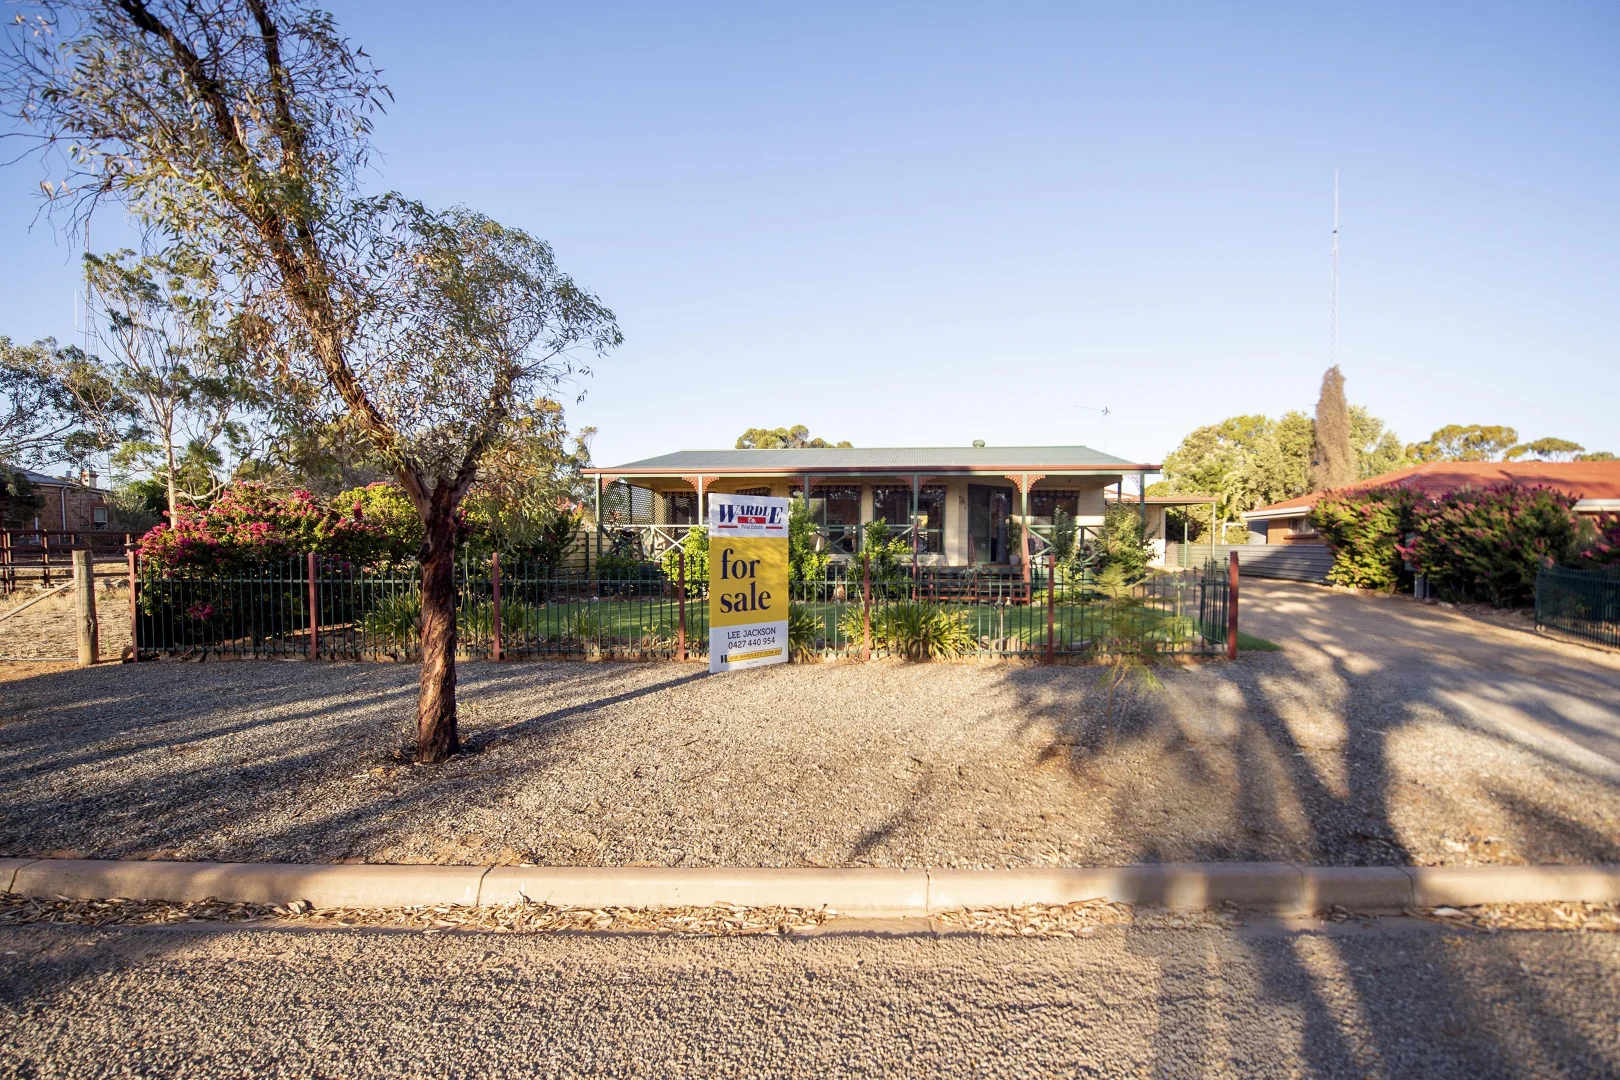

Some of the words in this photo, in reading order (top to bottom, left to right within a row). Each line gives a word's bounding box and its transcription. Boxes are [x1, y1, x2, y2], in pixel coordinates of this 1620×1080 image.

[718, 503, 783, 524] WARDLE
[720, 548, 761, 579] for
[720, 581, 772, 613] sale
[727, 630, 741, 639] LEE
[742, 627, 776, 638] JACKSON
[728, 640, 746, 650] 0427
[747, 639, 761, 647] 440
[762, 637, 775, 645] 954
